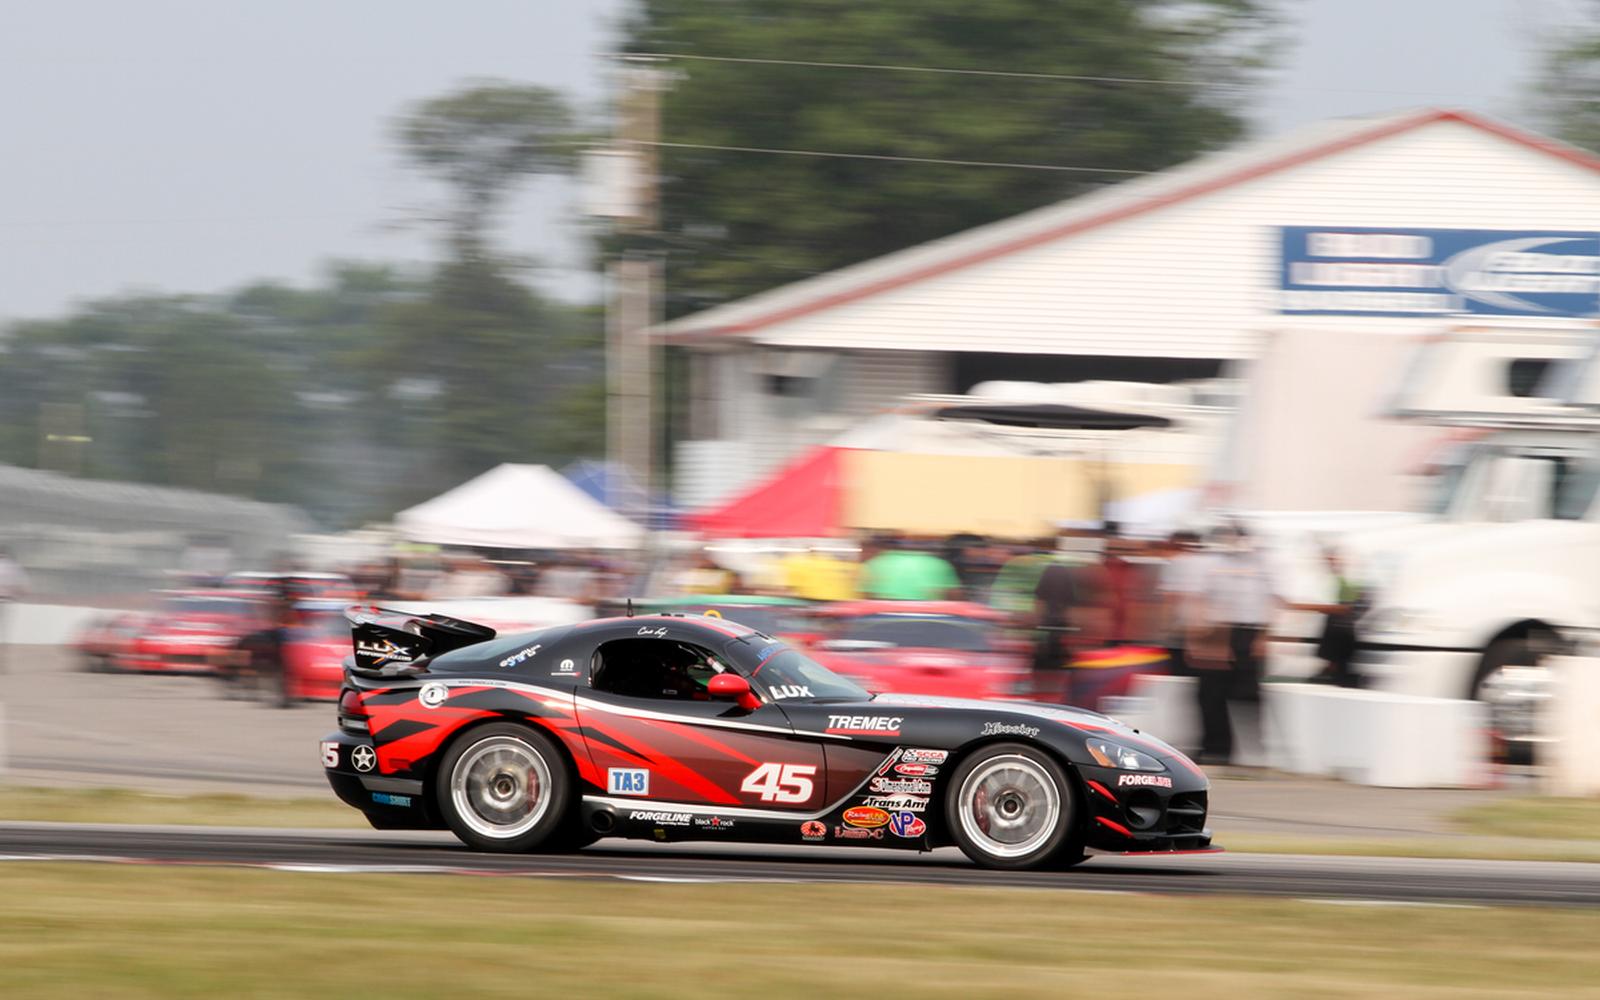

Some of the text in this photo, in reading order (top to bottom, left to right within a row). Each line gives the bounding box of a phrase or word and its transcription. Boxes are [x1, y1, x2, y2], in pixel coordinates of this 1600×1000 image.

[769, 685, 814, 700] LUX
[828, 715, 901, 730] TREMEC
[980, 721, 1040, 737] Hoosier
[613, 771, 645, 791] TA3
[740, 763, 817, 803] 45
[1118, 774, 1172, 788] FORGELINE
[868, 797, 925, 809] Trans Am
[629, 811, 693, 822] FORGELINE
[695, 818, 711, 826] black
[891, 812, 914, 836] VP
